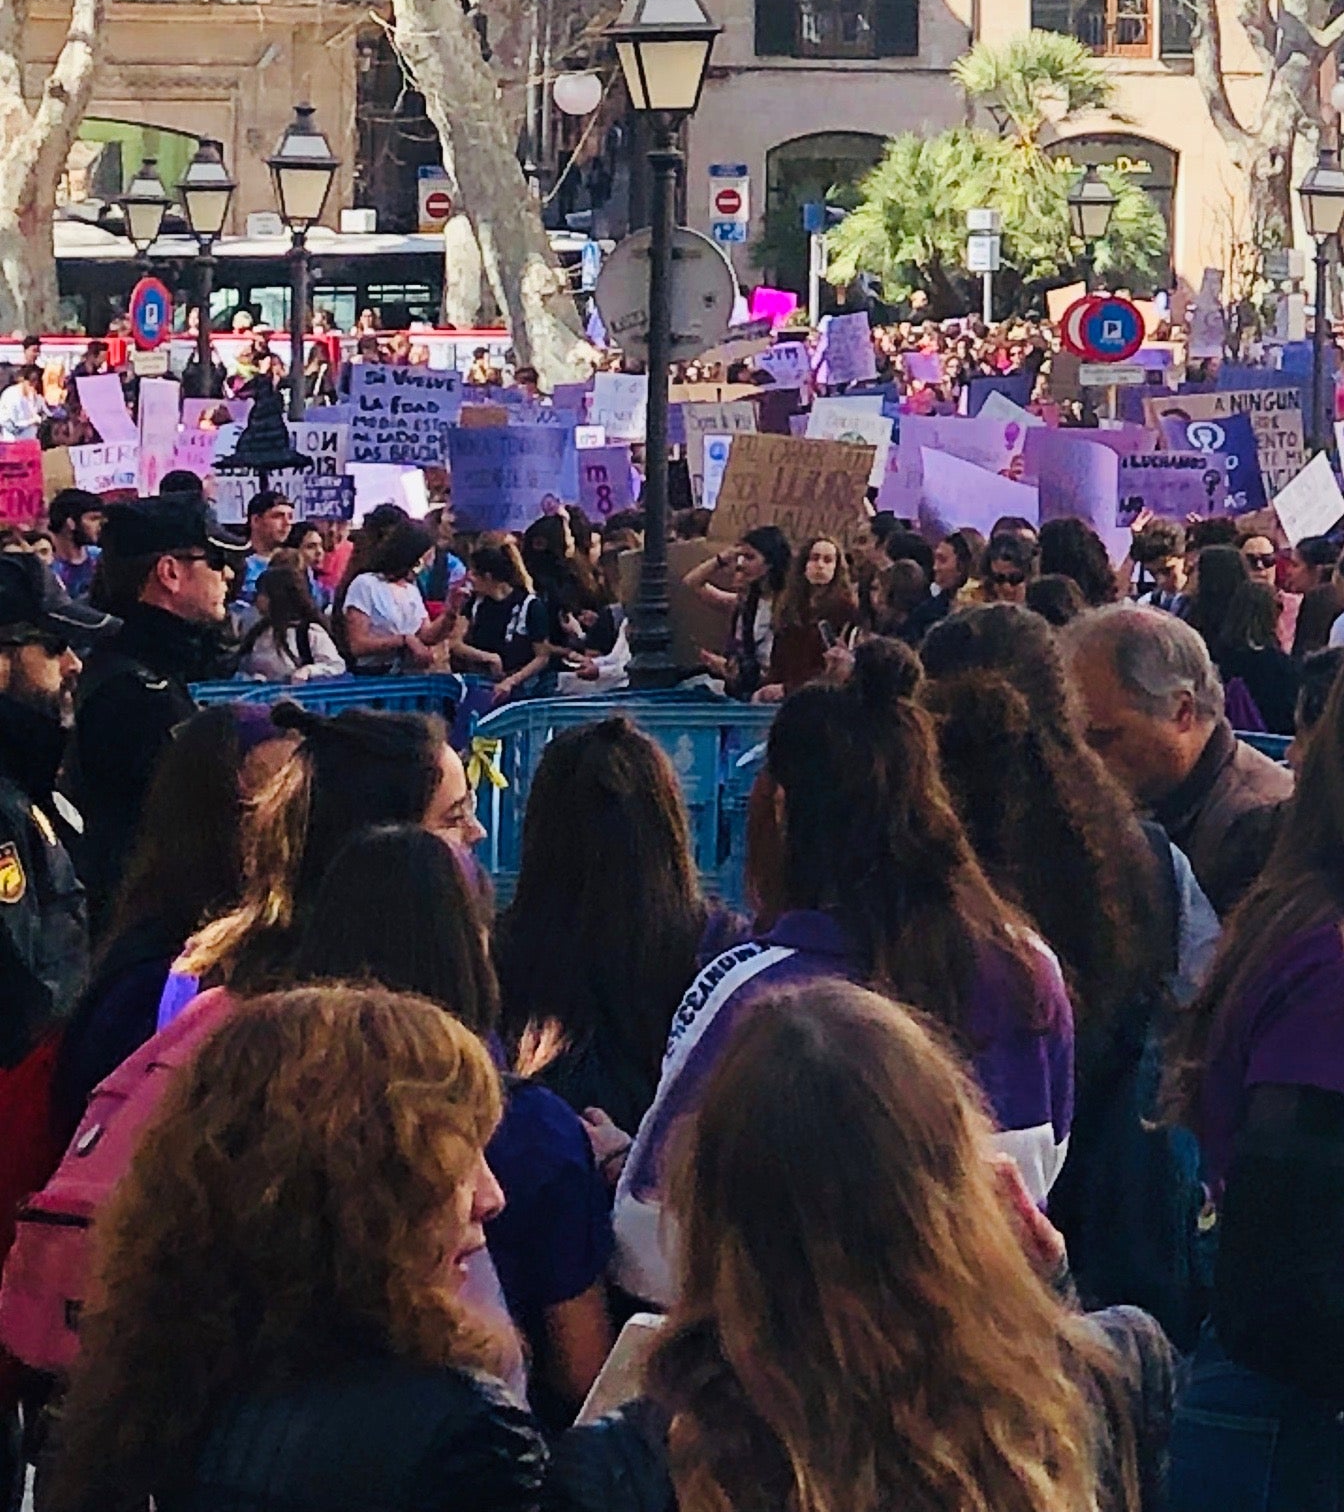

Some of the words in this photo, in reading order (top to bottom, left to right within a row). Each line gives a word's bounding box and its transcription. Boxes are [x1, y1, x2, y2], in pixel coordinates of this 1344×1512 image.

[392, 368, 457, 393] VUELVE
[359, 395, 384, 412] LA
[390, 396, 440, 415] EDAD
[352, 432, 372, 442] AL
[375, 431, 421, 444] LADO
[354, 445, 381, 460] LAS
[597, 484, 613, 515] 8
